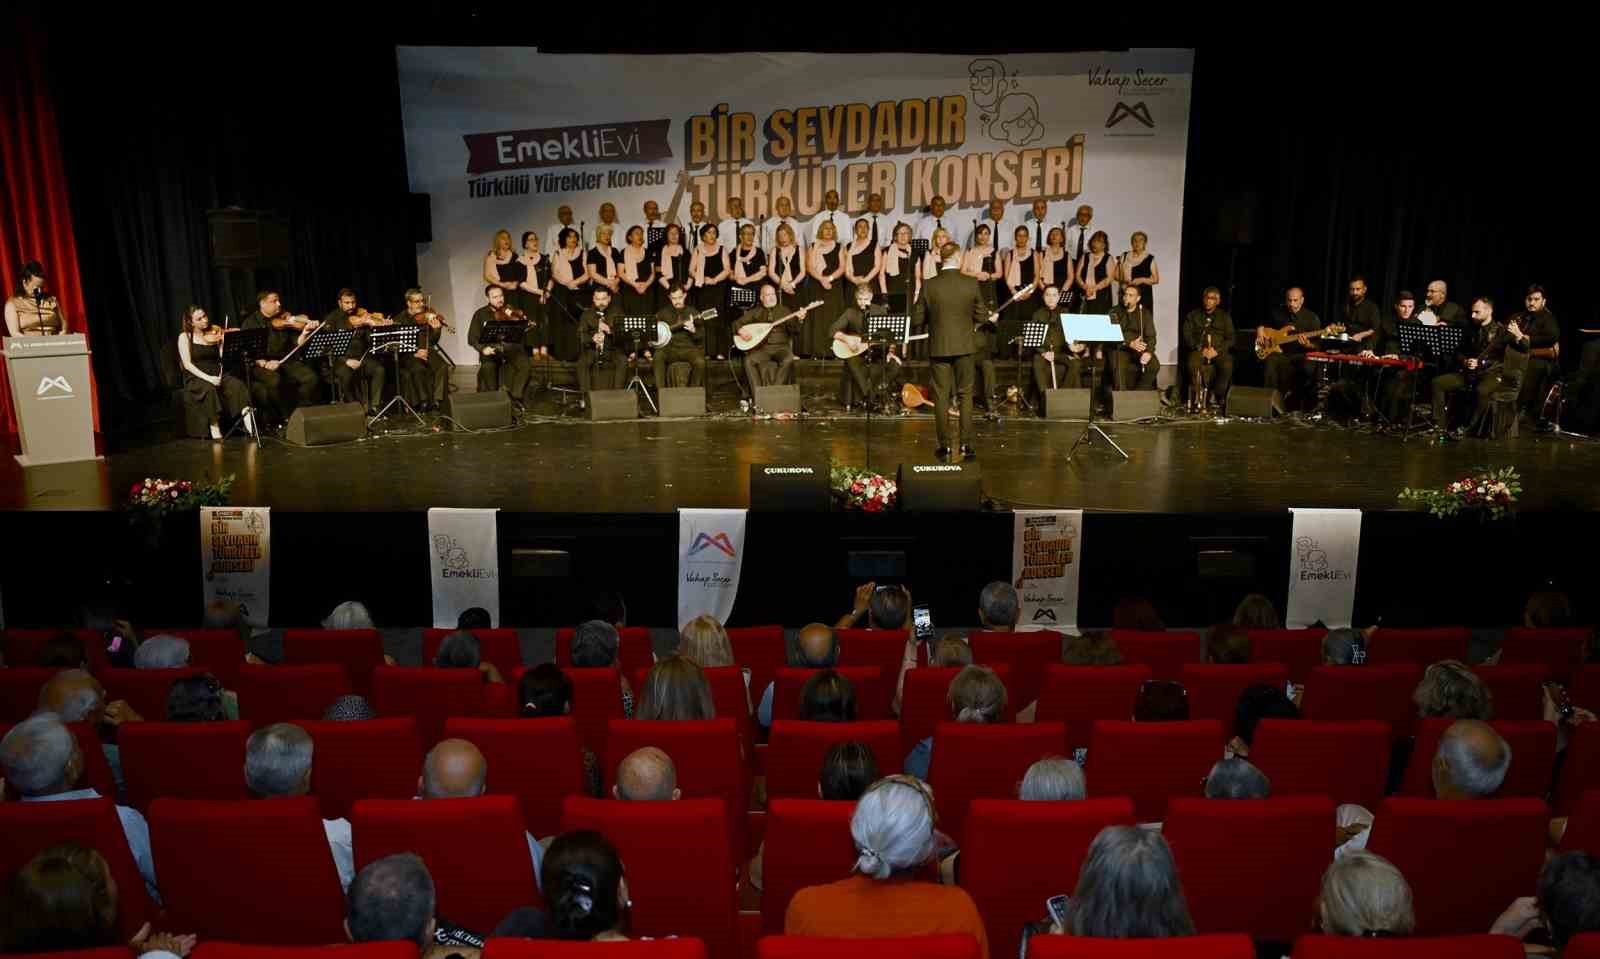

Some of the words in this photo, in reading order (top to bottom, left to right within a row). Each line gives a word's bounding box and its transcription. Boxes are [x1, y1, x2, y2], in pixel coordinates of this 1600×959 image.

[1088, 67, 1130, 95] Vahap
[495, 128, 641, 165] EmekliEvi
[691, 103, 755, 164] BİR
[769, 95, 966, 158] SEVDADIR
[467, 175, 530, 198] Türkülü
[533, 170, 604, 194] Yürekler
[607, 168, 665, 188] Korosu
[911, 135, 1084, 207] KONSERİ
